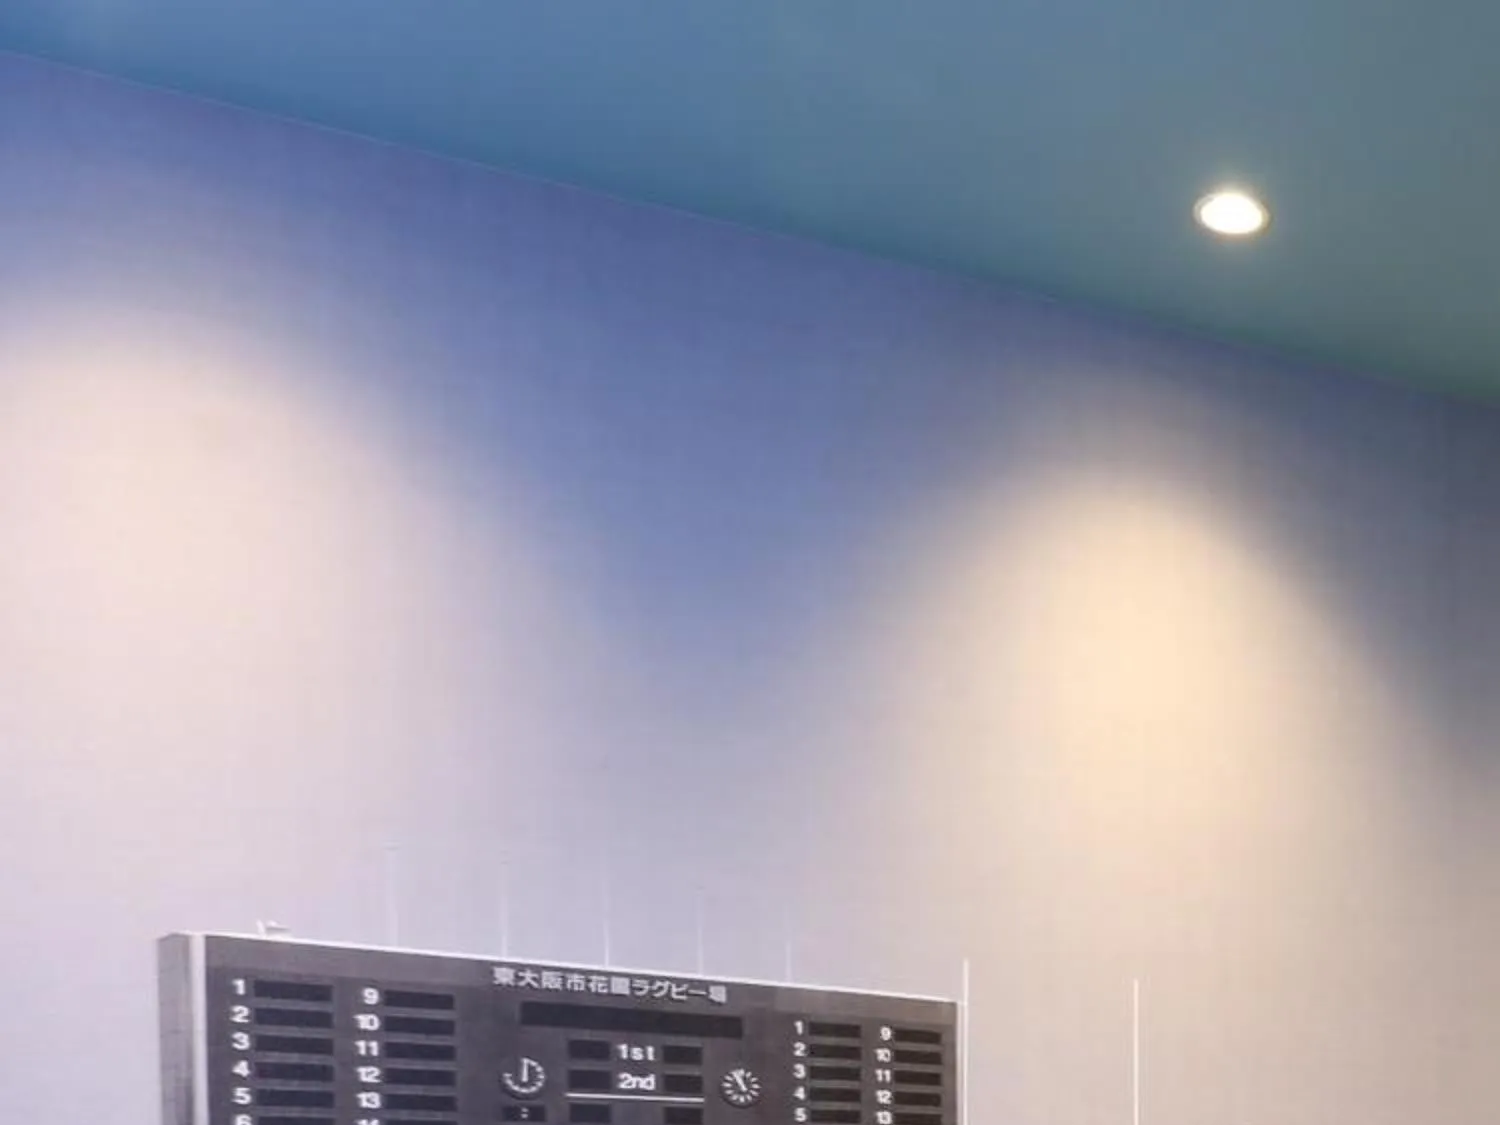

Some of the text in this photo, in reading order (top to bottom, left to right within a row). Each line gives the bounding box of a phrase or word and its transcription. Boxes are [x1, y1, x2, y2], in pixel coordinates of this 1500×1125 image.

[233, 978, 246, 995] 1
[363, 988, 379, 1005] 9
[231, 1005, 249, 1023] 2
[355, 1014, 380, 1031] 10
[794, 1020, 803, 1035] 1
[880, 1026, 892, 1041] 9
[232, 1031, 250, 1050] 3
[355, 1039, 379, 1057] 11
[794, 1041, 806, 1057] 2
[618, 1043, 655, 1061] 1st
[875, 1048, 891, 1063] 10
[232, 1060, 251, 1077] 4
[357, 1066, 380, 1083] 12
[793, 1063, 806, 1079] 3
[875, 1068, 891, 1082] 11
[619, 1072, 655, 1091] 2nd
[234, 1087, 252, 1105] 5
[357, 1092, 381, 1109] 13
[794, 1086, 806, 1100] 4
[876, 1089, 892, 1104] 12
[795, 1107, 807, 1122] 5
[876, 1110, 892, 1125] 13
